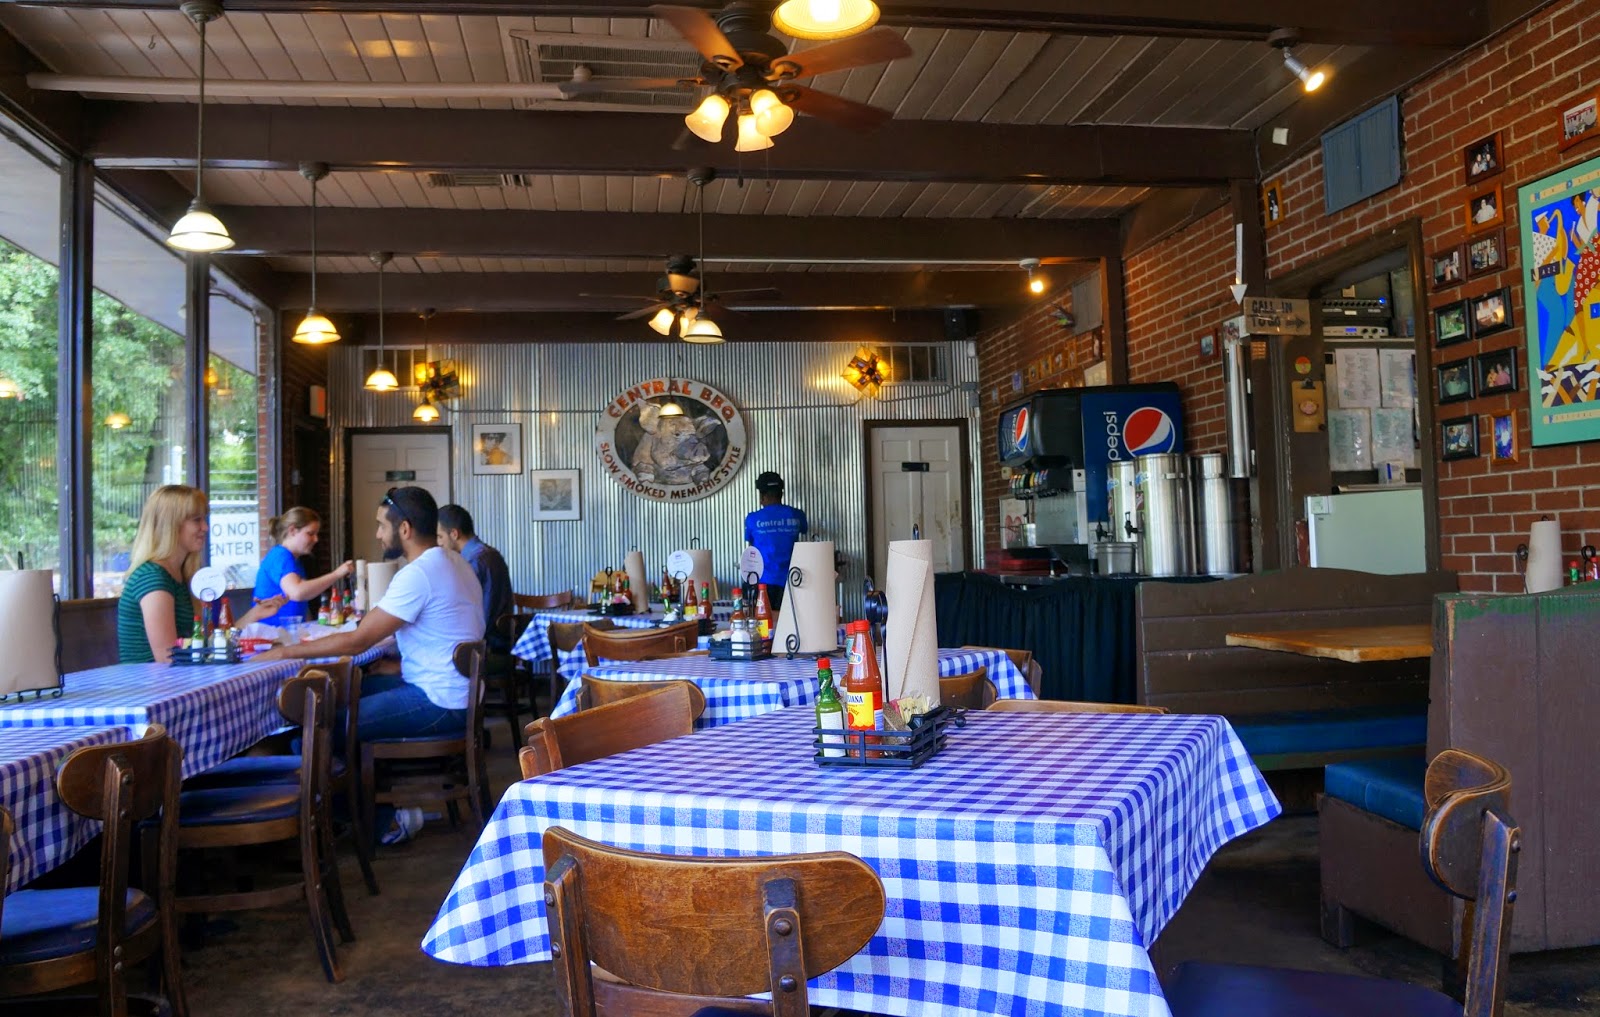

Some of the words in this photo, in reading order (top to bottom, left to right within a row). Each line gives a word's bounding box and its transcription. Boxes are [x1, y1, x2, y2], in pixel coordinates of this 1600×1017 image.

[1282, 301, 1293, 313] IN
[609, 381, 692, 417] CENTRAL
[701, 388, 736, 423] BBQ
[1103, 411, 1123, 461] pepsi
[601, 442, 621, 472] SLOW
[621, 475, 665, 498] SMOKED
[671, 475, 721, 498] MEMPHIS
[723, 446, 741, 475] STYLE
[210, 523, 222, 537] O
[227, 522, 256, 536] NOT
[757, 519, 784, 528] Central
[209, 541, 254, 557] ENTER
